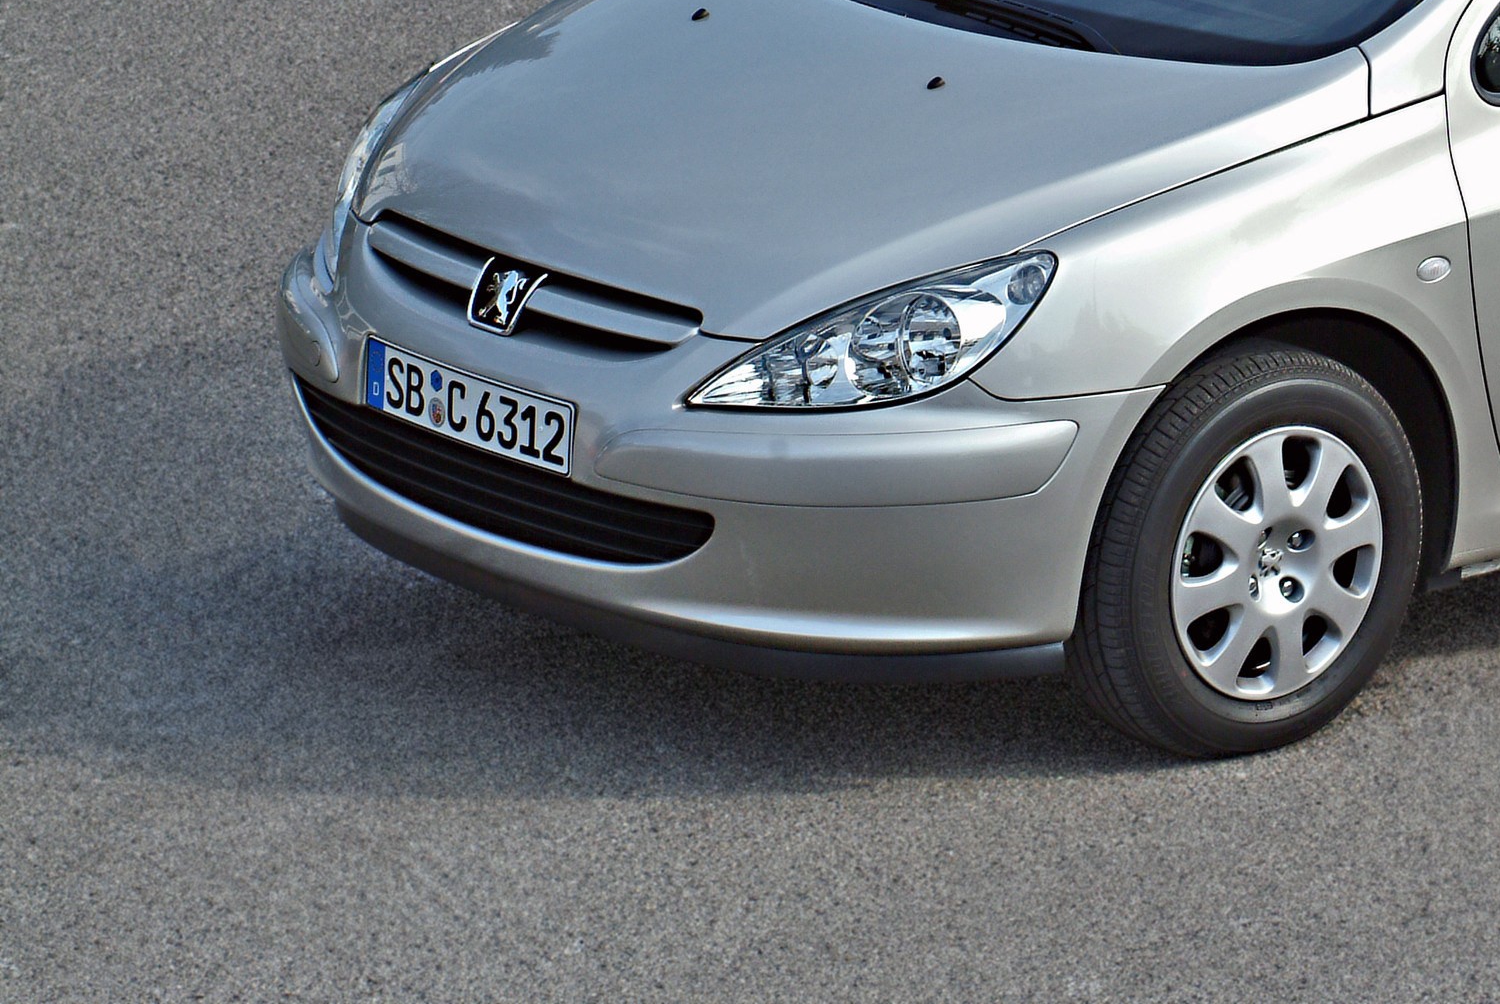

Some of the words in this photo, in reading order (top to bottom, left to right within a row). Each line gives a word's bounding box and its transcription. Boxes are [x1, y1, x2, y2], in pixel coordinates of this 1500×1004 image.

[386, 357, 425, 417] SB
[447, 379, 468, 433] C
[475, 390, 565, 467] 6312
